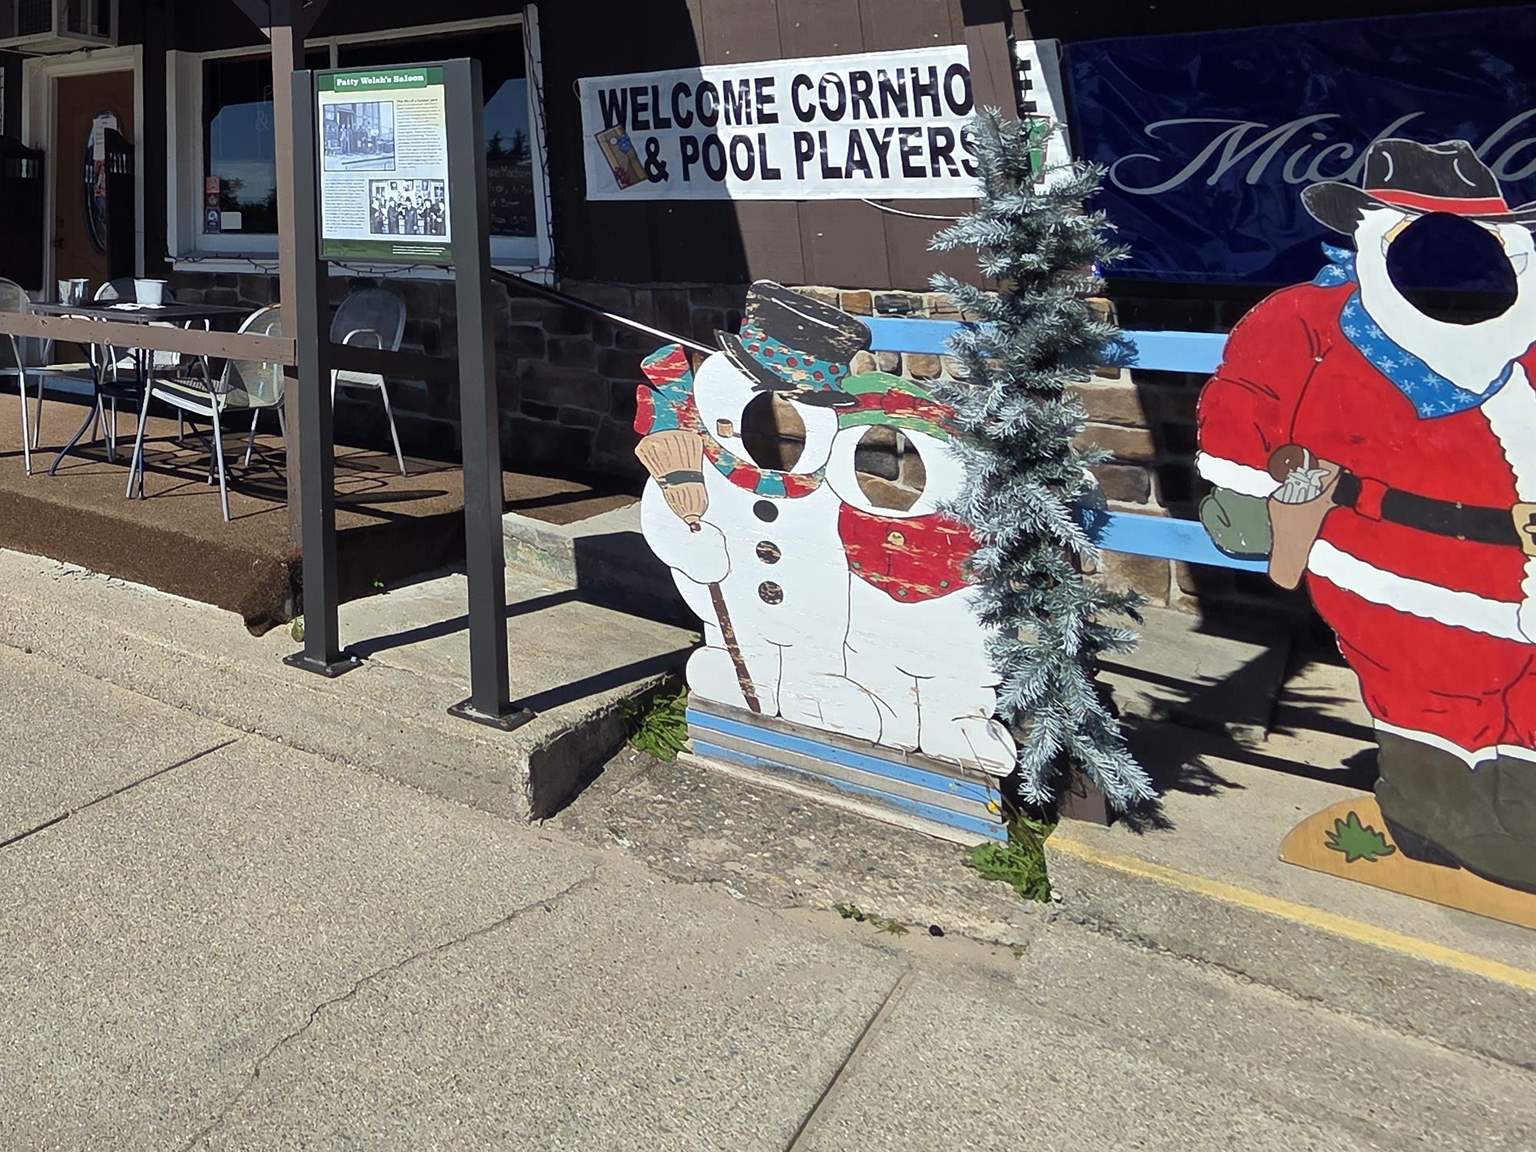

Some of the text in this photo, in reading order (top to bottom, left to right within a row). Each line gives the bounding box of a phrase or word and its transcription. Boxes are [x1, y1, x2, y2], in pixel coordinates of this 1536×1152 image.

[393, 75, 424, 83] Saloon
[598, 59, 1038, 131] WELCOME CORNHOE
[643, 125, 983, 184] & POOL PLAYERS
